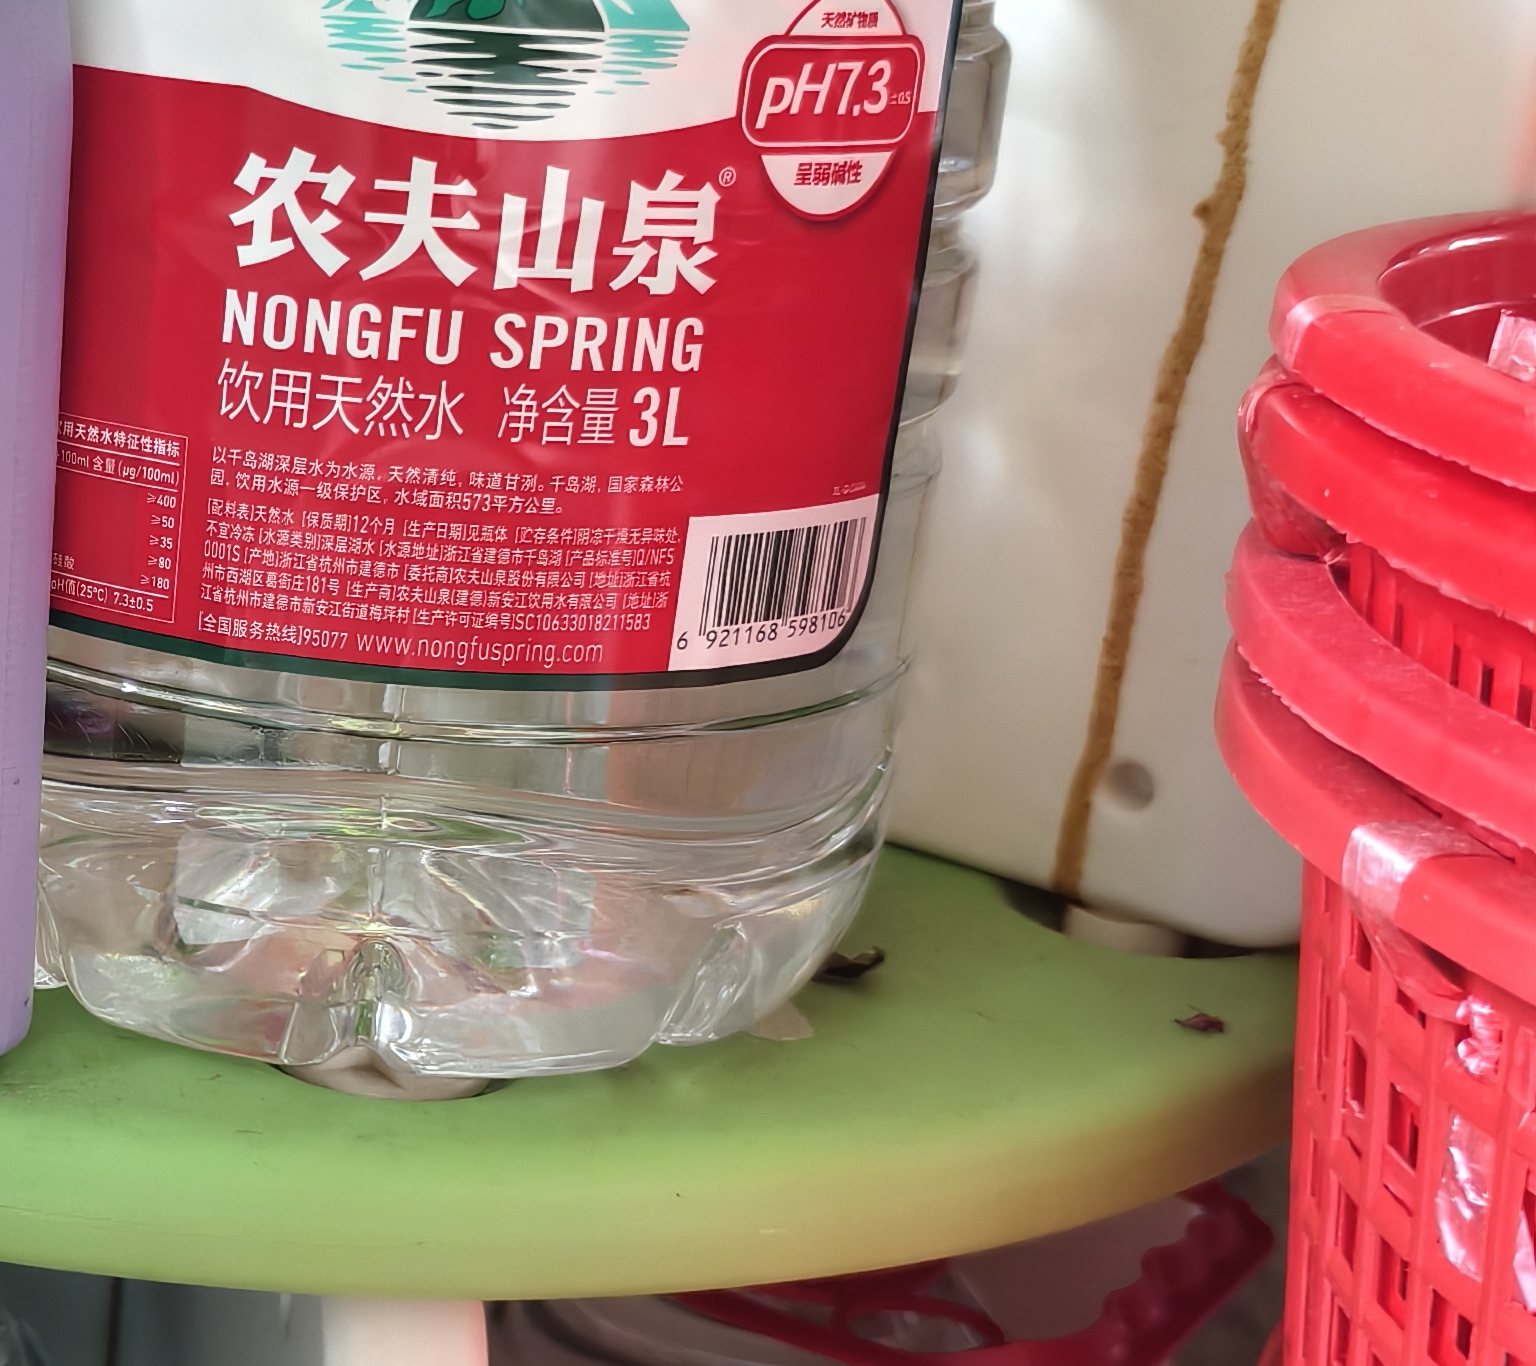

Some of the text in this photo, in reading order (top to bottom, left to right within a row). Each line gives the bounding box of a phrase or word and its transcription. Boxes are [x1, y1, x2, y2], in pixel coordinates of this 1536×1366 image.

[793, 159, 863, 187] 呈弱碱性
[228, 146, 722, 295] 农夫山泉
[221, 288, 704, 372] NONGFU SPRING
[217, 358, 690, 447] 饮用天然水 净含量 3L
[356, 634, 604, 668] www.nongfuspring.com
[705, 622, 779, 649] 921168
[786, 608, 847, 638] 598106
